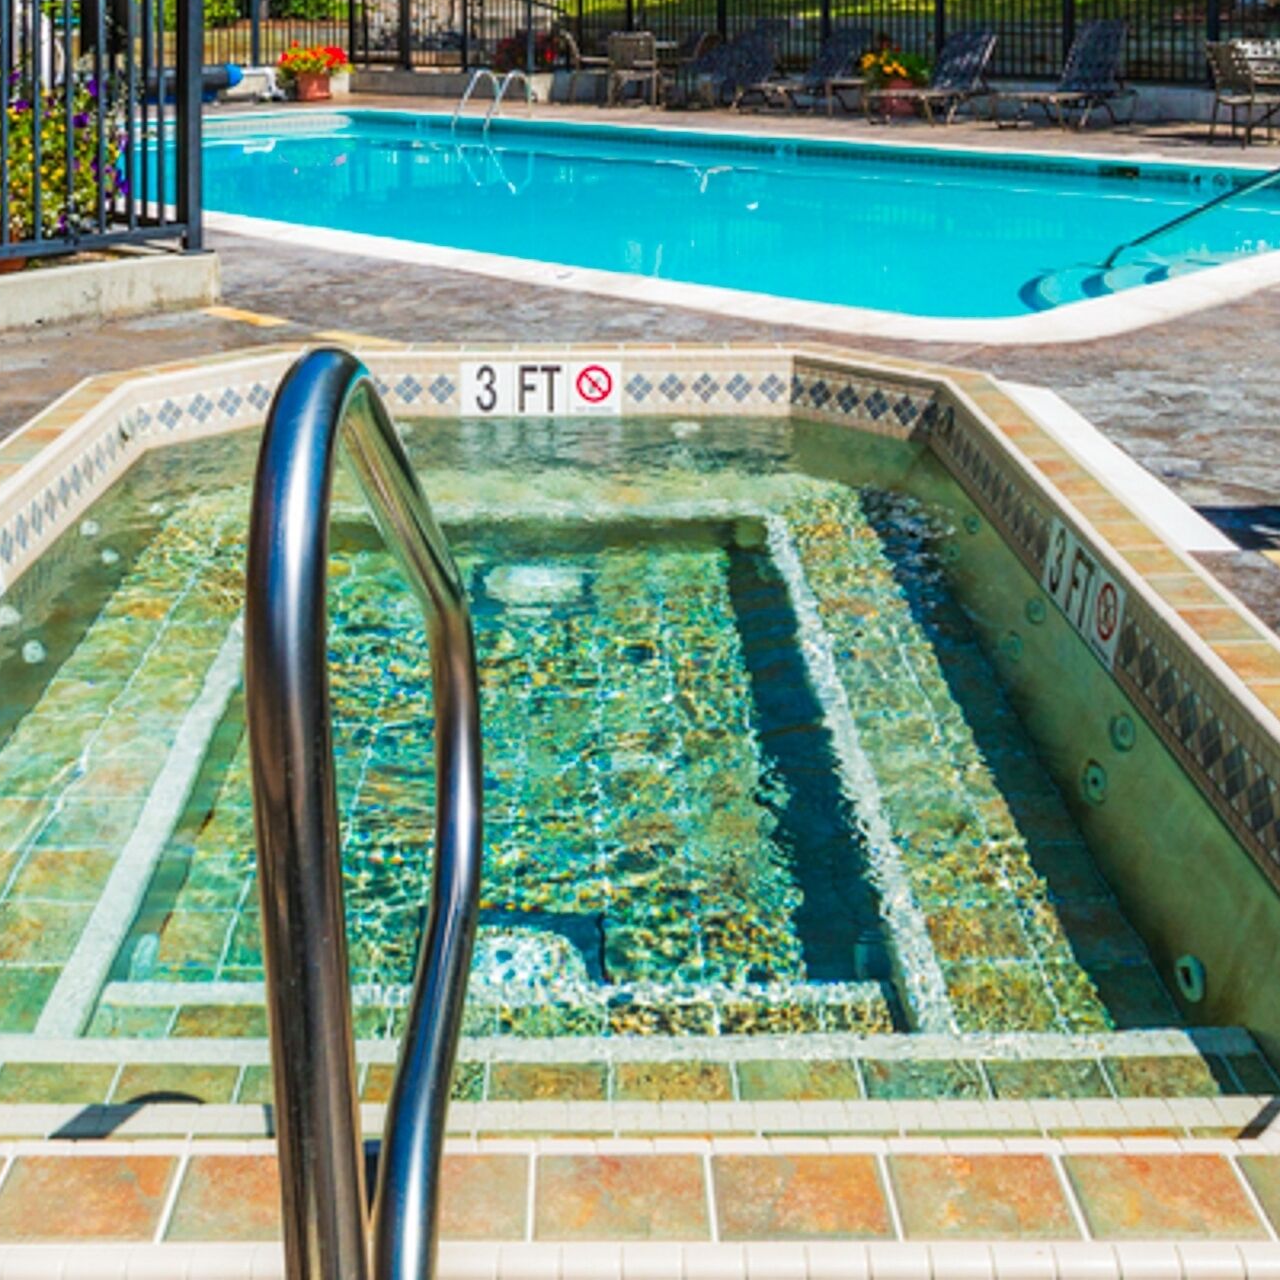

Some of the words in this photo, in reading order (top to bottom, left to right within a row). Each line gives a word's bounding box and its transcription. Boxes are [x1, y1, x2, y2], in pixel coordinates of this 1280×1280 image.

[476, 364, 497, 412] 3
[519, 365, 561, 412] FT
[1050, 528, 1066, 594] 3
[1064, 546, 1096, 628] FT
